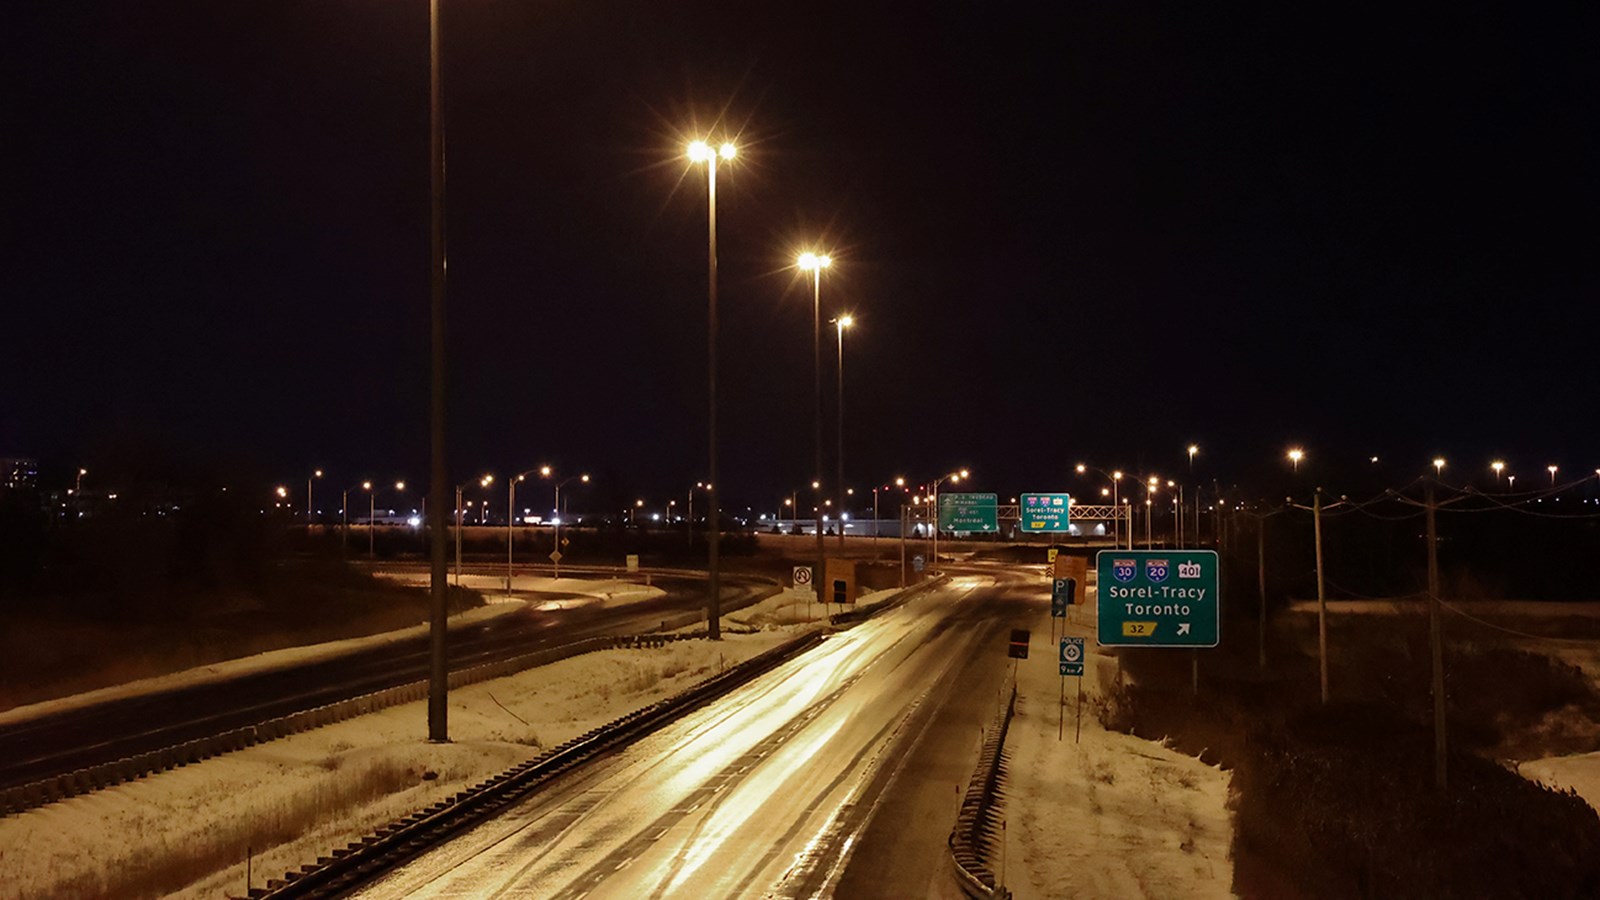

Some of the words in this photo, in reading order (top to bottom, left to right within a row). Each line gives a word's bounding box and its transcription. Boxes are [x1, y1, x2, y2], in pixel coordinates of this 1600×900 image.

[1118, 567, 1132, 577] 30
[1149, 567, 1166, 577] 20
[1181, 567, 1200, 577] 401
[1056, 580, 1065, 593] P
[1109, 586, 1206, 601] Sorel-Tracy
[1125, 603, 1190, 616] Toronto
[1130, 625, 1145, 634] 32
